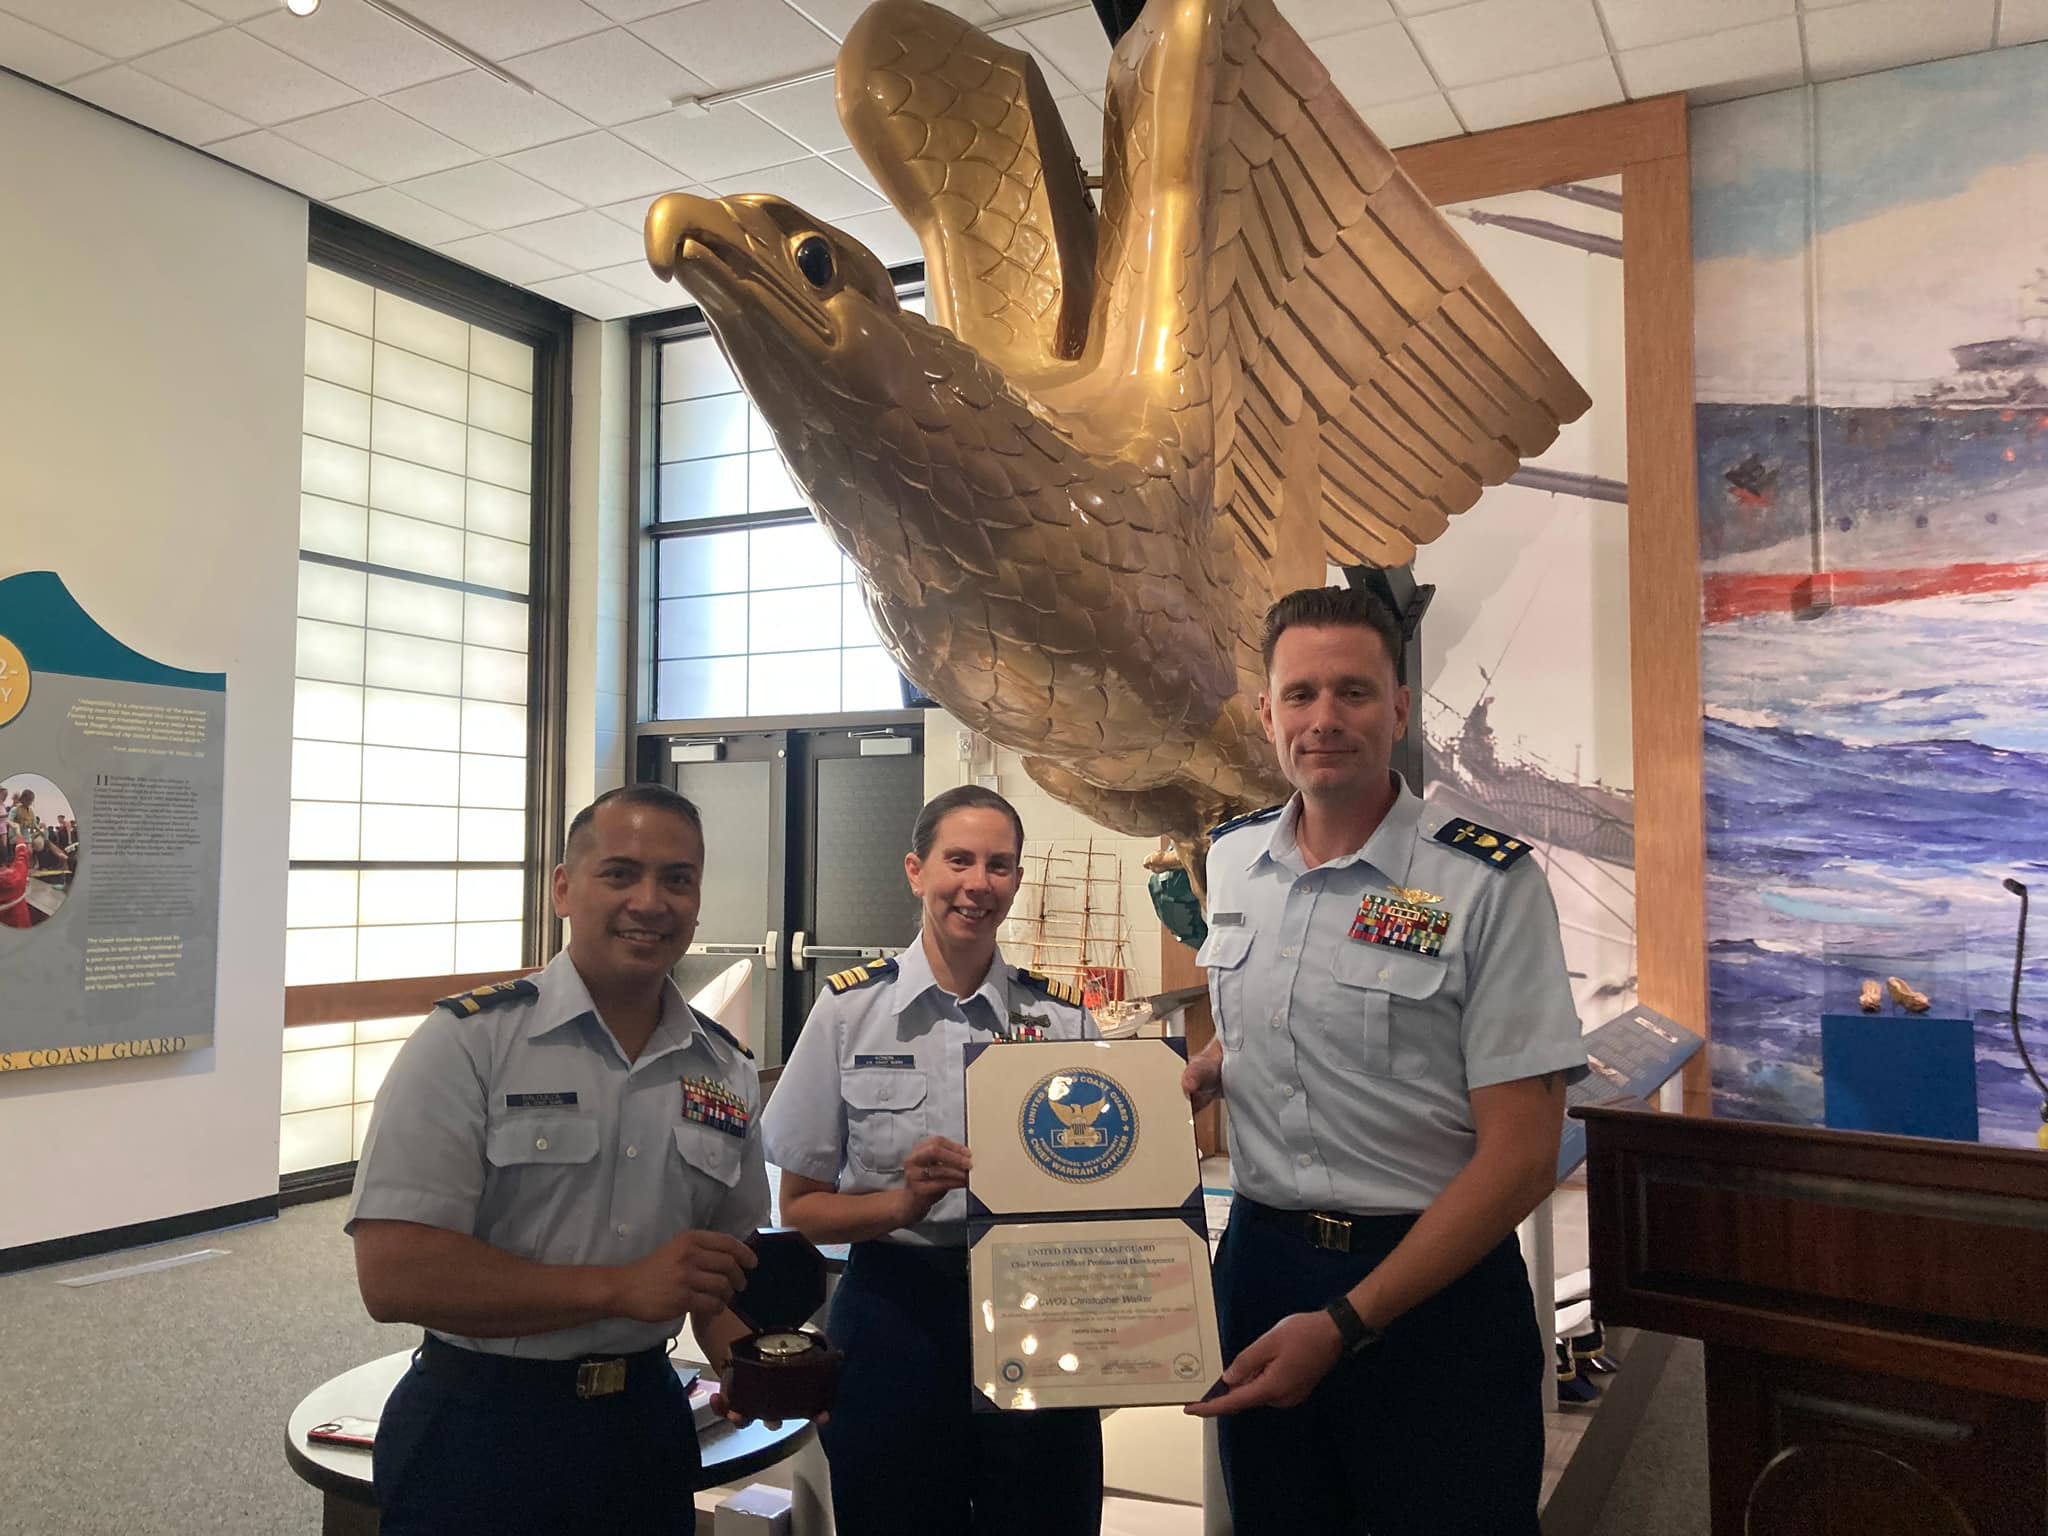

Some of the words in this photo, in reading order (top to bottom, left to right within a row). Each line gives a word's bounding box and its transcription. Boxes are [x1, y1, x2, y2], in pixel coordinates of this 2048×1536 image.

[29, 1045, 105, 1067] COAST
[112, 1036, 186, 1058] GUARD
[1028, 1091, 1045, 1124] UNITED
[1080, 1076, 1109, 1091] COAST
[1110, 1091, 1129, 1121] GUARD
[1031, 1138, 1052, 1162] CHIEF
[1052, 1160, 1099, 1176] WARRANT
[1101, 1135, 1129, 1169] OFFICER
[1027, 1247, 1061, 1256] UNITED
[1062, 1246, 1094, 1255] STATES
[1094, 1245, 1123, 1254] COAST
[1125, 1244, 1156, 1253] GUARD
